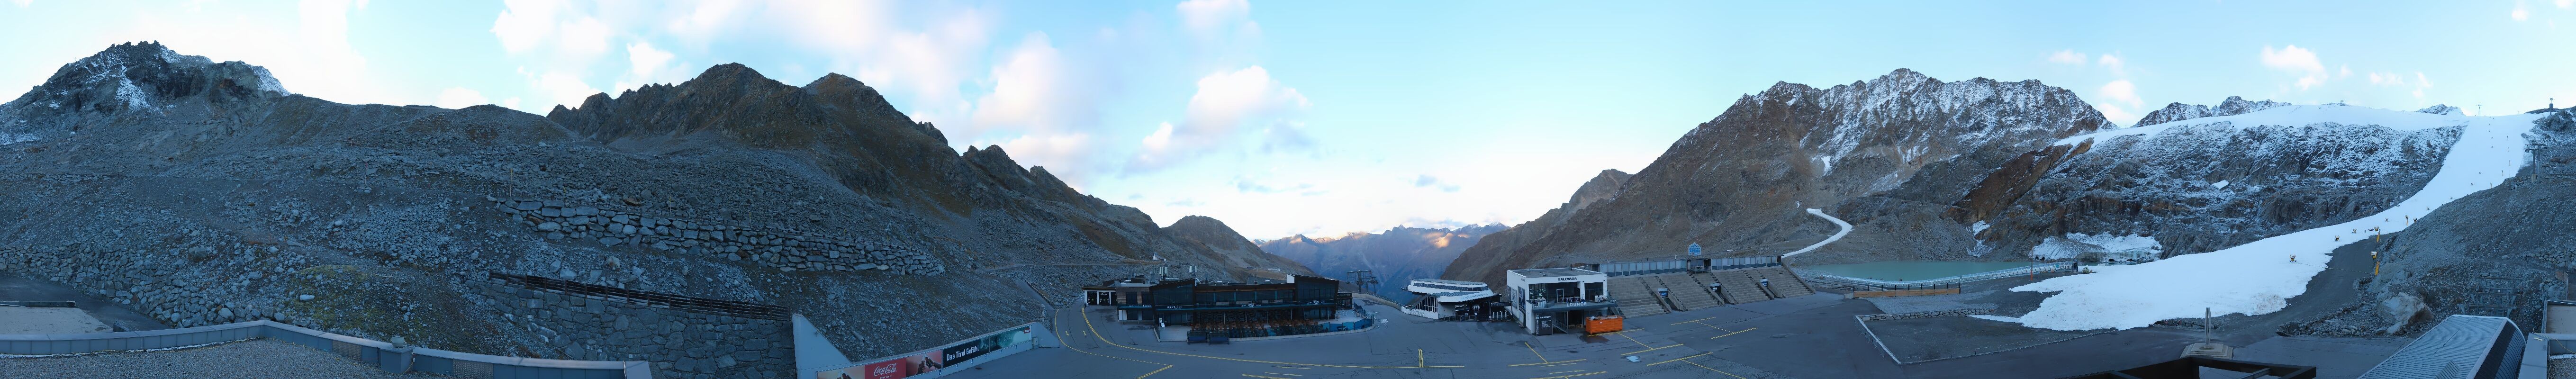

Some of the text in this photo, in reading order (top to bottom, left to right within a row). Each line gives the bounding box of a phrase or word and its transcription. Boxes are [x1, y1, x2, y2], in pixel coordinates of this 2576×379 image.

[956, 349, 966, 358] Tirol
[966, 345, 979, 354] Gefühl
[874, 363, 897, 376] Coca-Cola
